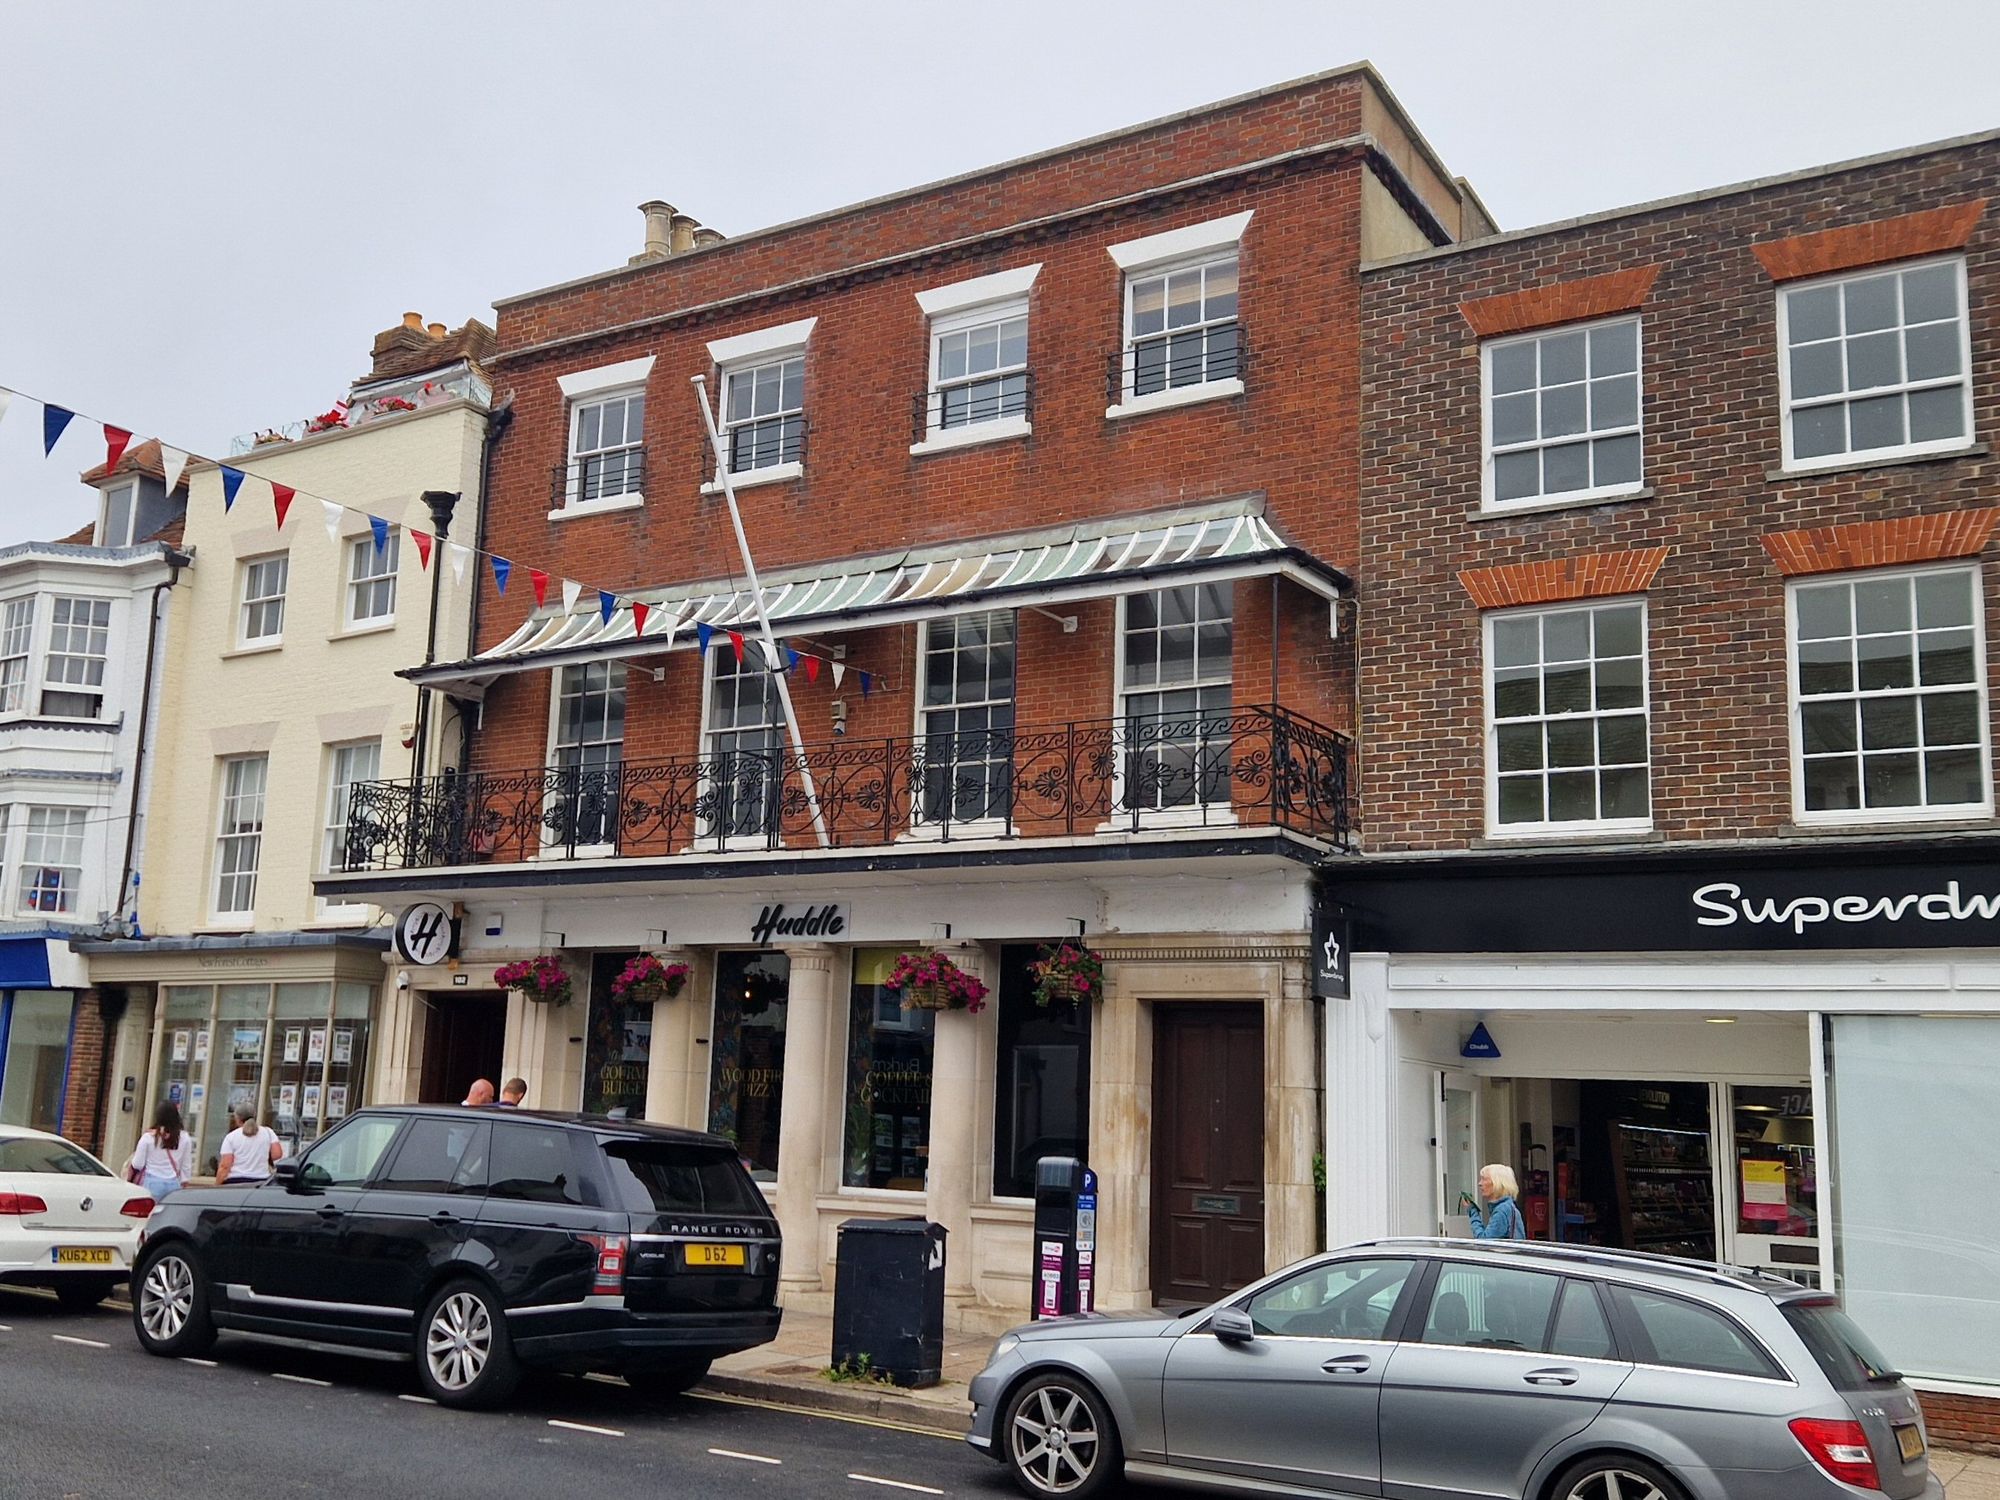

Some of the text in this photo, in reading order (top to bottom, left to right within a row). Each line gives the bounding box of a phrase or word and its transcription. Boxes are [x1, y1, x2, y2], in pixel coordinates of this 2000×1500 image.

[751, 904, 844, 947] Huddle
[410, 912, 443, 959] H
[721, 1068, 761, 1082] WOOD
[742, 1083, 777, 1097] PIZZA
[1084, 1173, 1092, 1188] P
[671, 1225, 763, 1235] RANGE ROVER
[59, 1250, 110, 1261] KU62 XCD
[704, 1247, 727, 1262] D 62
